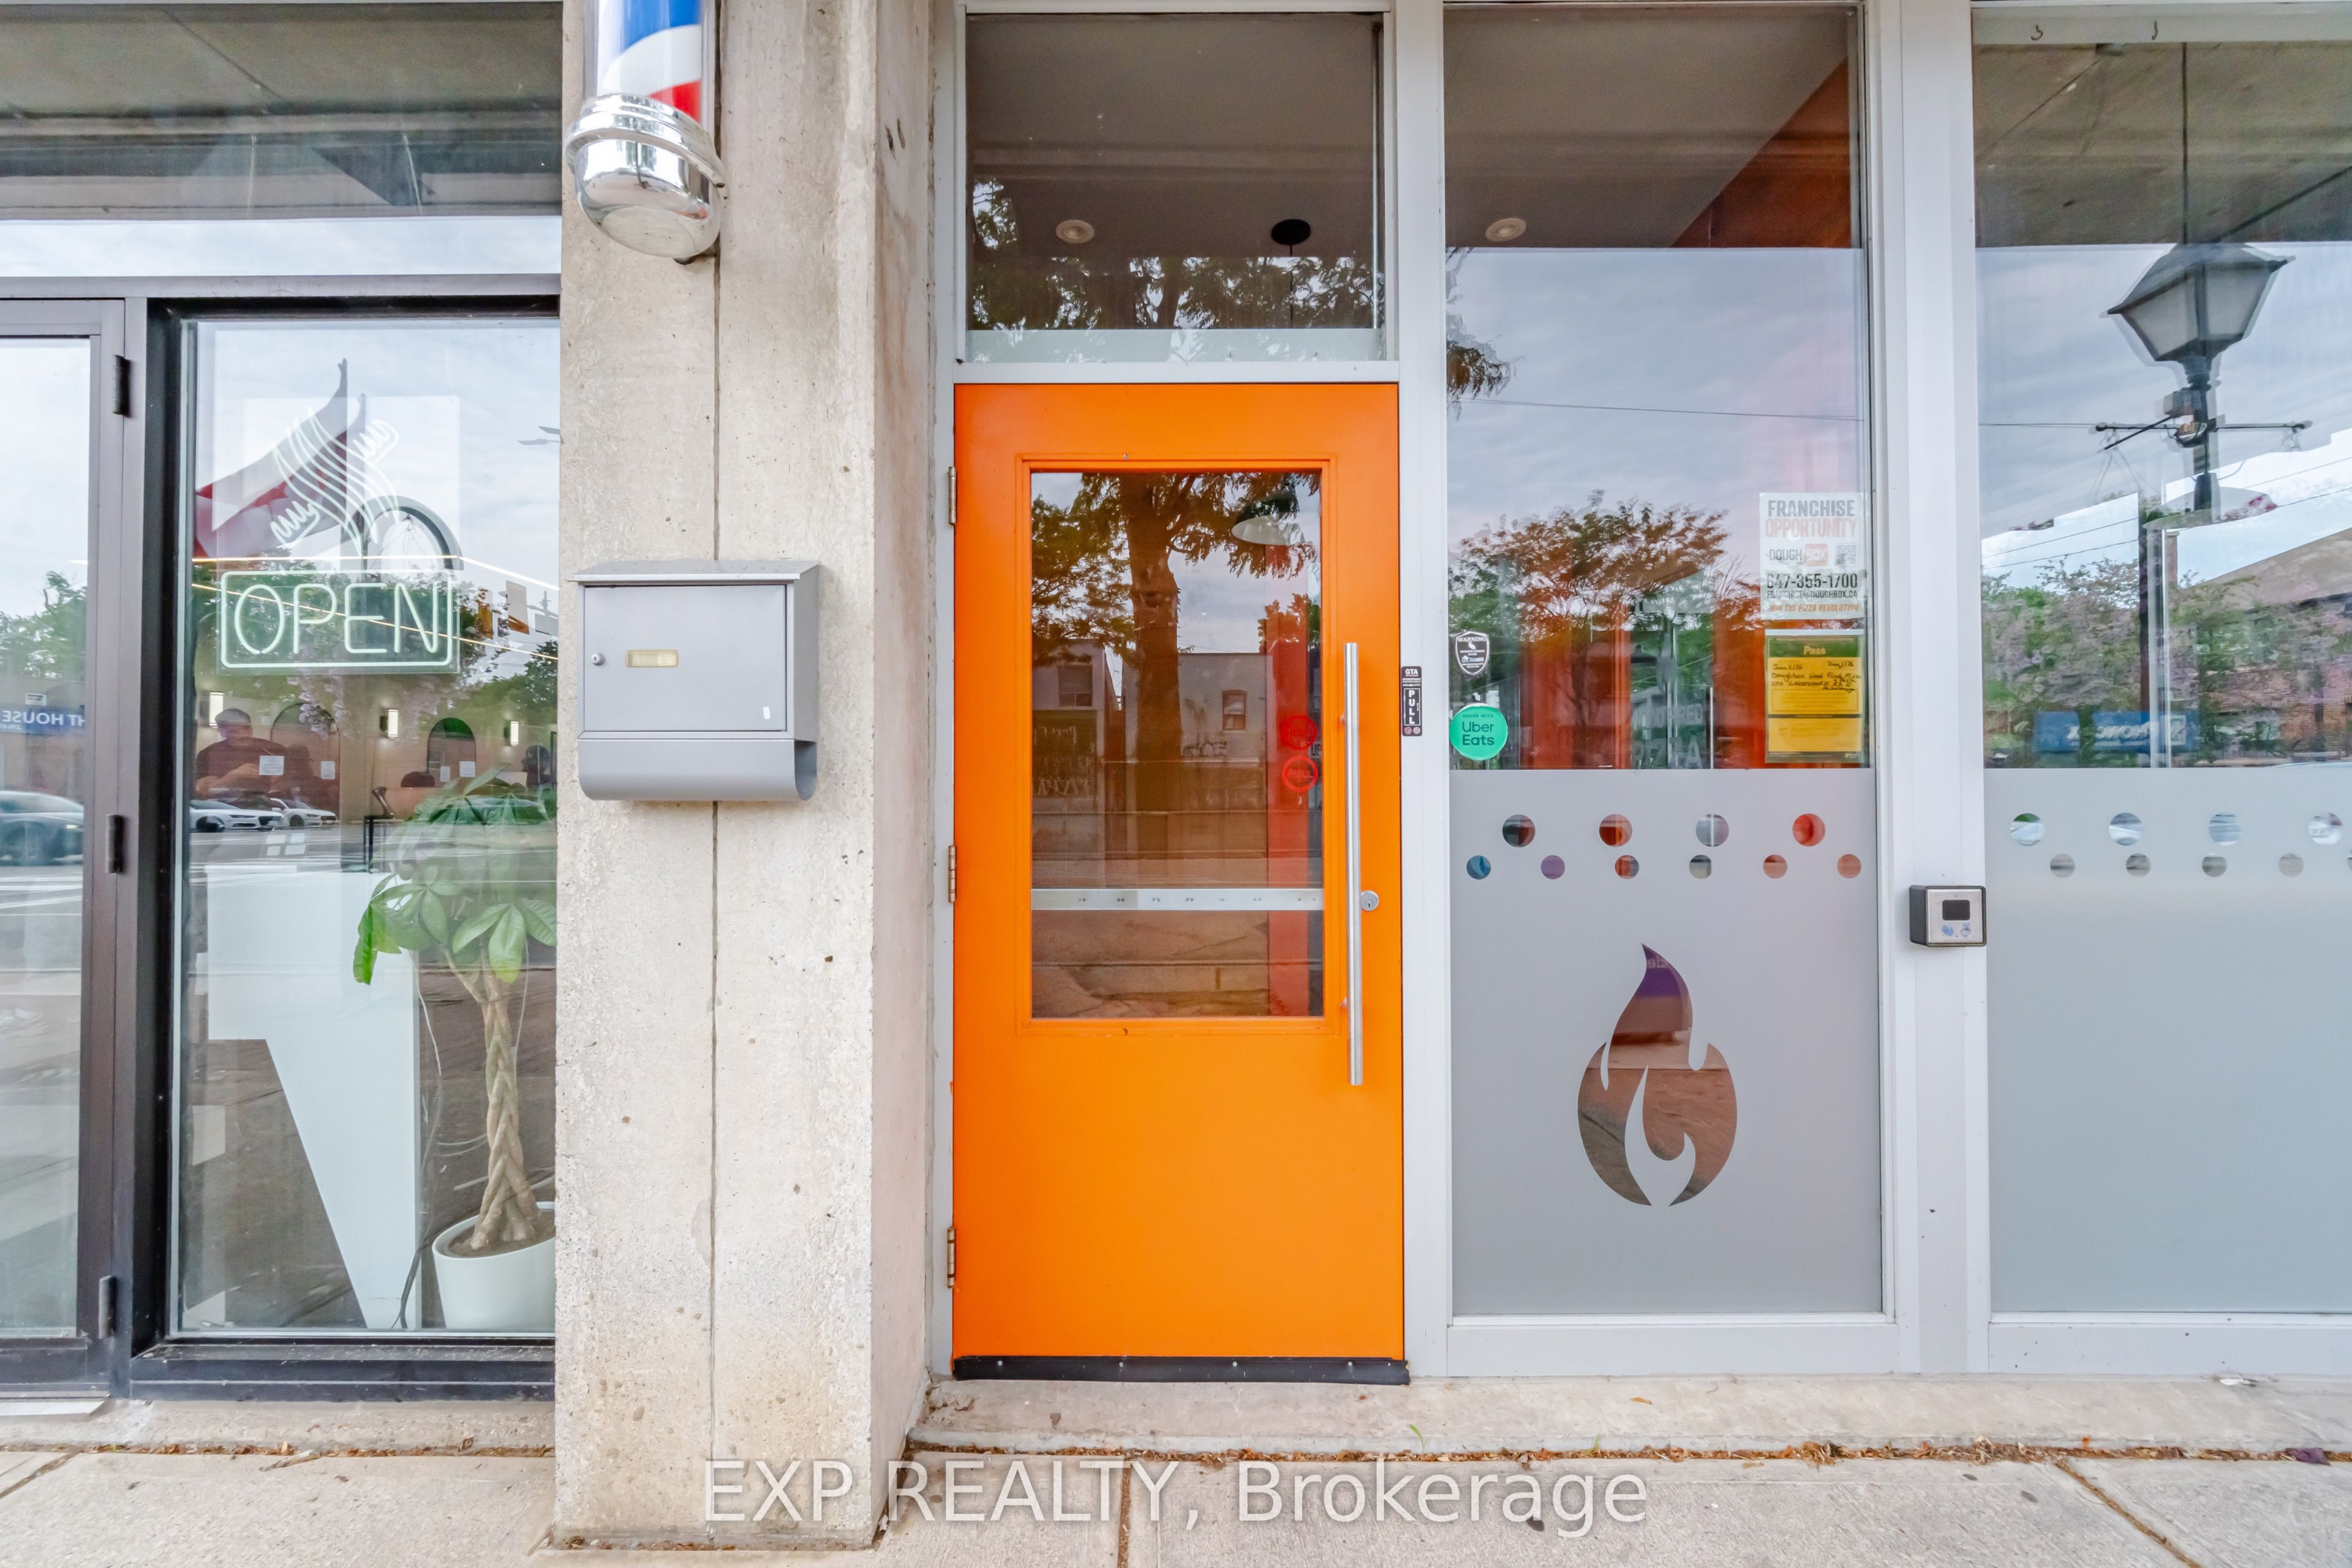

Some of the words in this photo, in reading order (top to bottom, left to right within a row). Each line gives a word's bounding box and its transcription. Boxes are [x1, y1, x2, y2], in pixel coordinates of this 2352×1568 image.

[1768, 500, 1855, 517] FRANCHISE
[1765, 518, 1857, 538] OPPORTUNITY
[1769, 549, 1802, 560] DOUGH
[1806, 549, 1826, 560] BOX
[1766, 573, 1858, 589] 647-355-1700
[234, 582, 439, 655] OPEN
[1803, 646, 1826, 655] Pass
[1462, 721, 1494, 733] Uber
[1462, 734, 1494, 745] Eats
